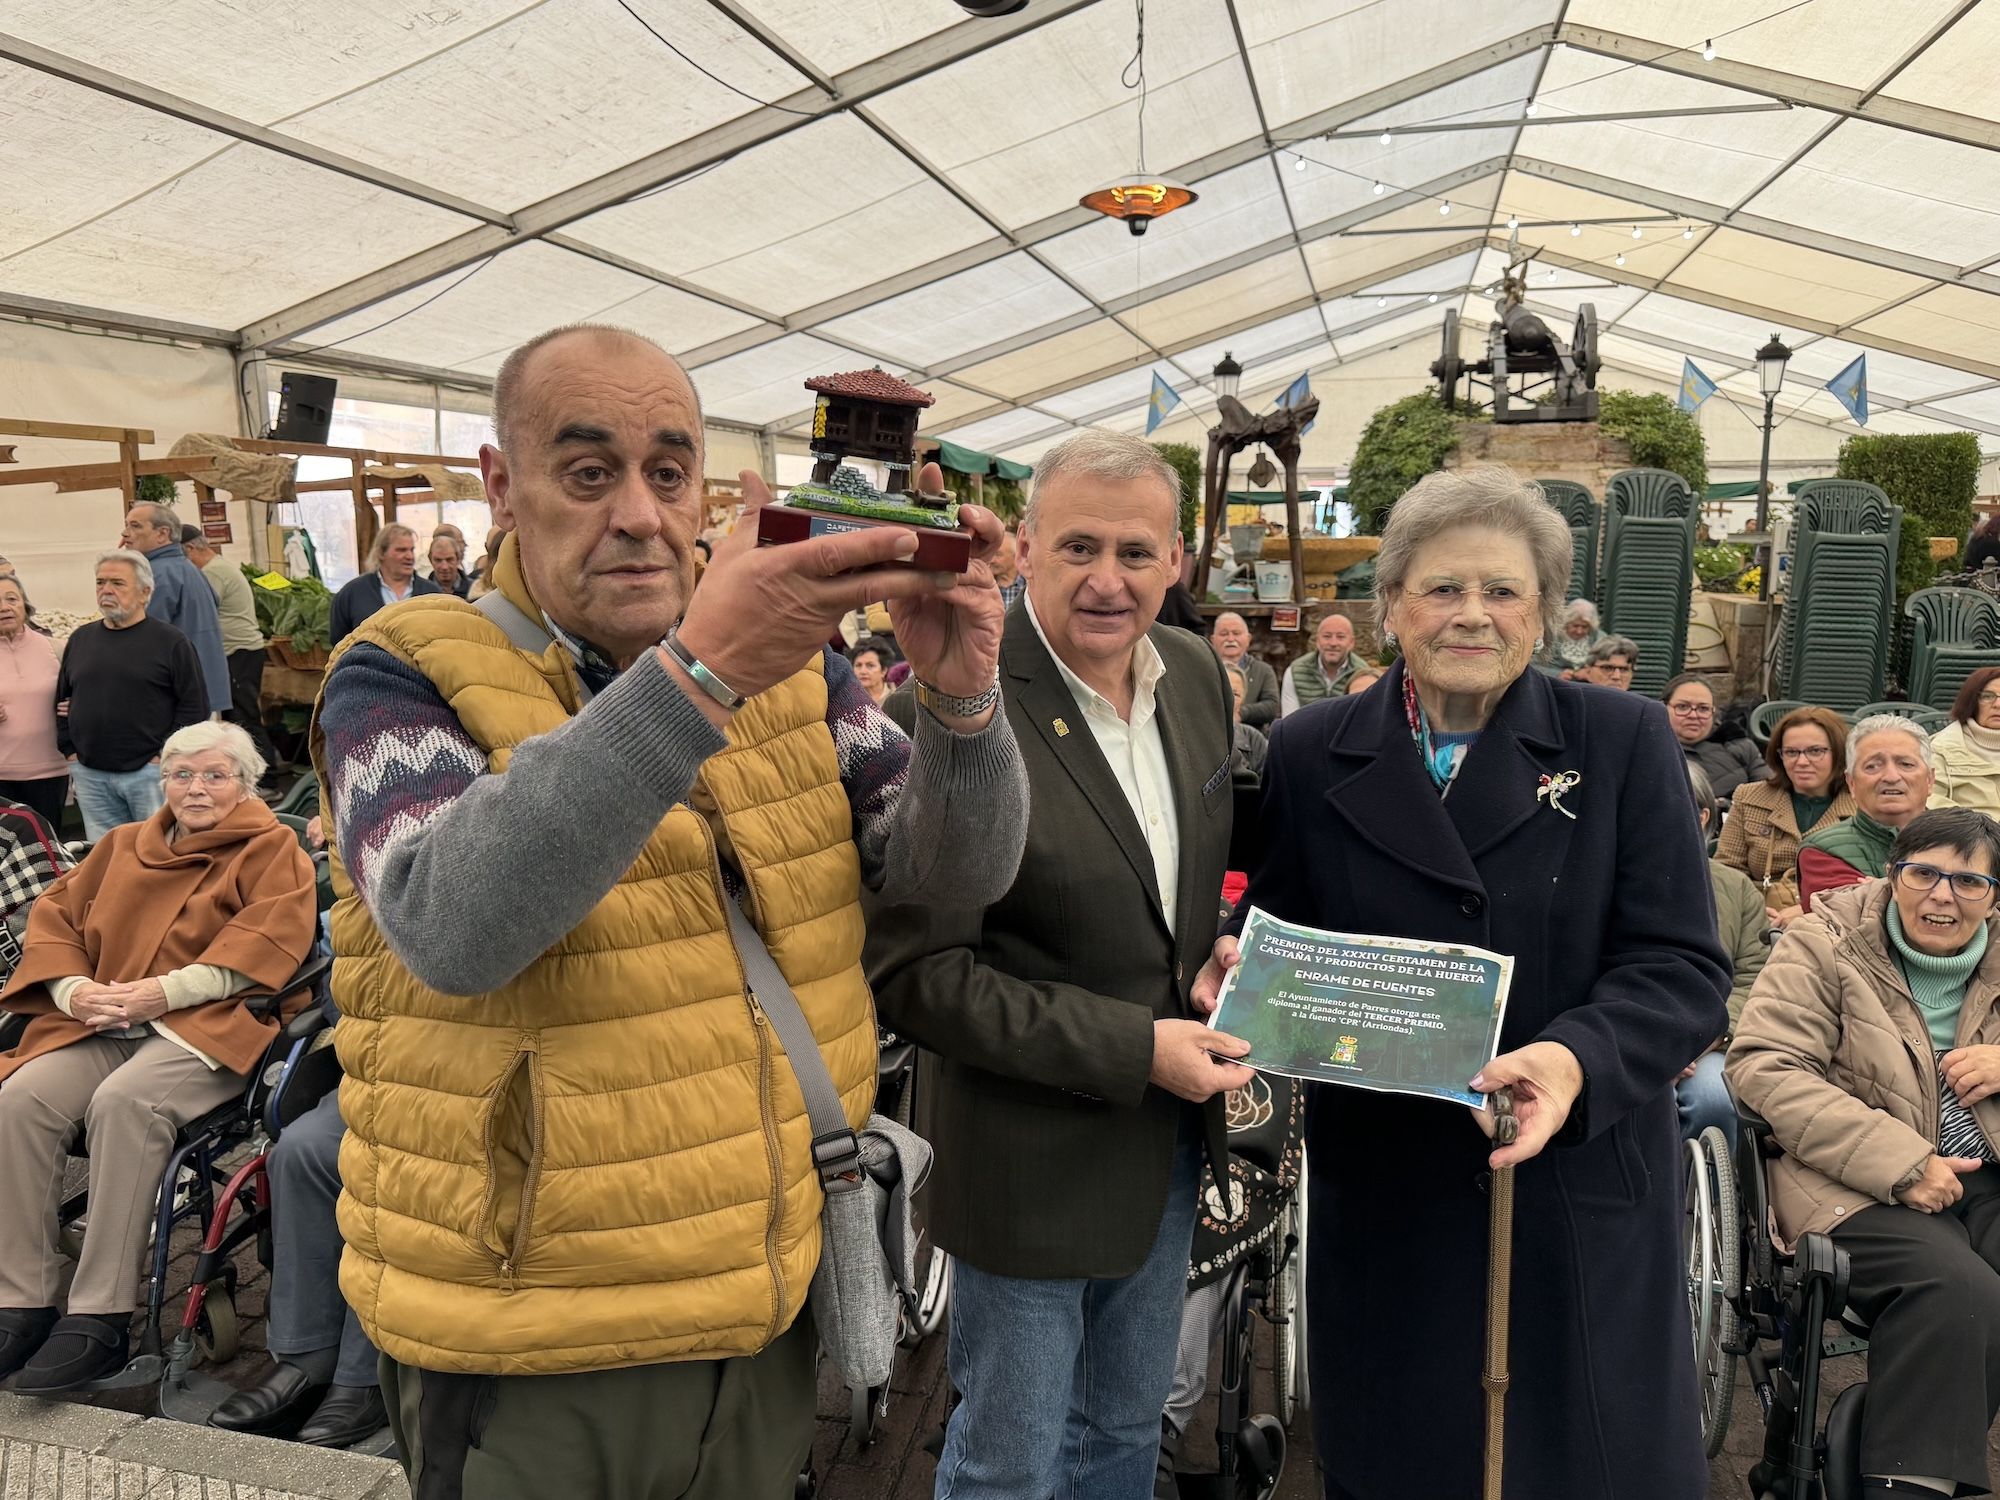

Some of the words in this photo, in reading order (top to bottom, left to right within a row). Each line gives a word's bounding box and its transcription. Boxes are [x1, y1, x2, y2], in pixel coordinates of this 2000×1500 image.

[1259, 944, 1311, 962] CASTAÑA
[1314, 955, 1323, 963] Y
[1325, 957, 1396, 972] PRODUCTOS
[1397, 966, 1415, 975] DE
[1416, 968, 1432, 978] LA
[1434, 970, 1485, 984] HUERTA
[1264, 934, 1315, 953] PREMIOS
[1317, 946, 1339, 956] DEL
[1341, 950, 1380, 960] XXXIV
[1382, 954, 1447, 968] CERTAMEN
[1449, 961, 1467, 971] DE
[1469, 963, 1485, 973] LA
[1294, 969, 1350, 985] ENRAME
[1352, 977, 1371, 988] DE
[1373, 980, 1436, 997] FUENTES
[1267, 997, 1300, 1009] diploma
[1311, 1005, 1347, 1016] ganador
[1348, 1010, 1362, 1018] del
[1364, 1011, 1402, 1024] TERCER
[1403, 1017, 1447, 1031] PREMIO.
[1288, 992, 1347, 1007] Ayuntamiento
[1348, 1001, 1360, 1009] de
[1361, 1003, 1389, 1013] Parres
[1390, 1007, 1420, 1018] otorga
[1421, 1012, 1441, 1020] este
[1299, 1011, 1307, 1019] la
[1309, 1012, 1337, 1023] fuente
[1362, 1020, 1415, 1035] (Arriondas).
